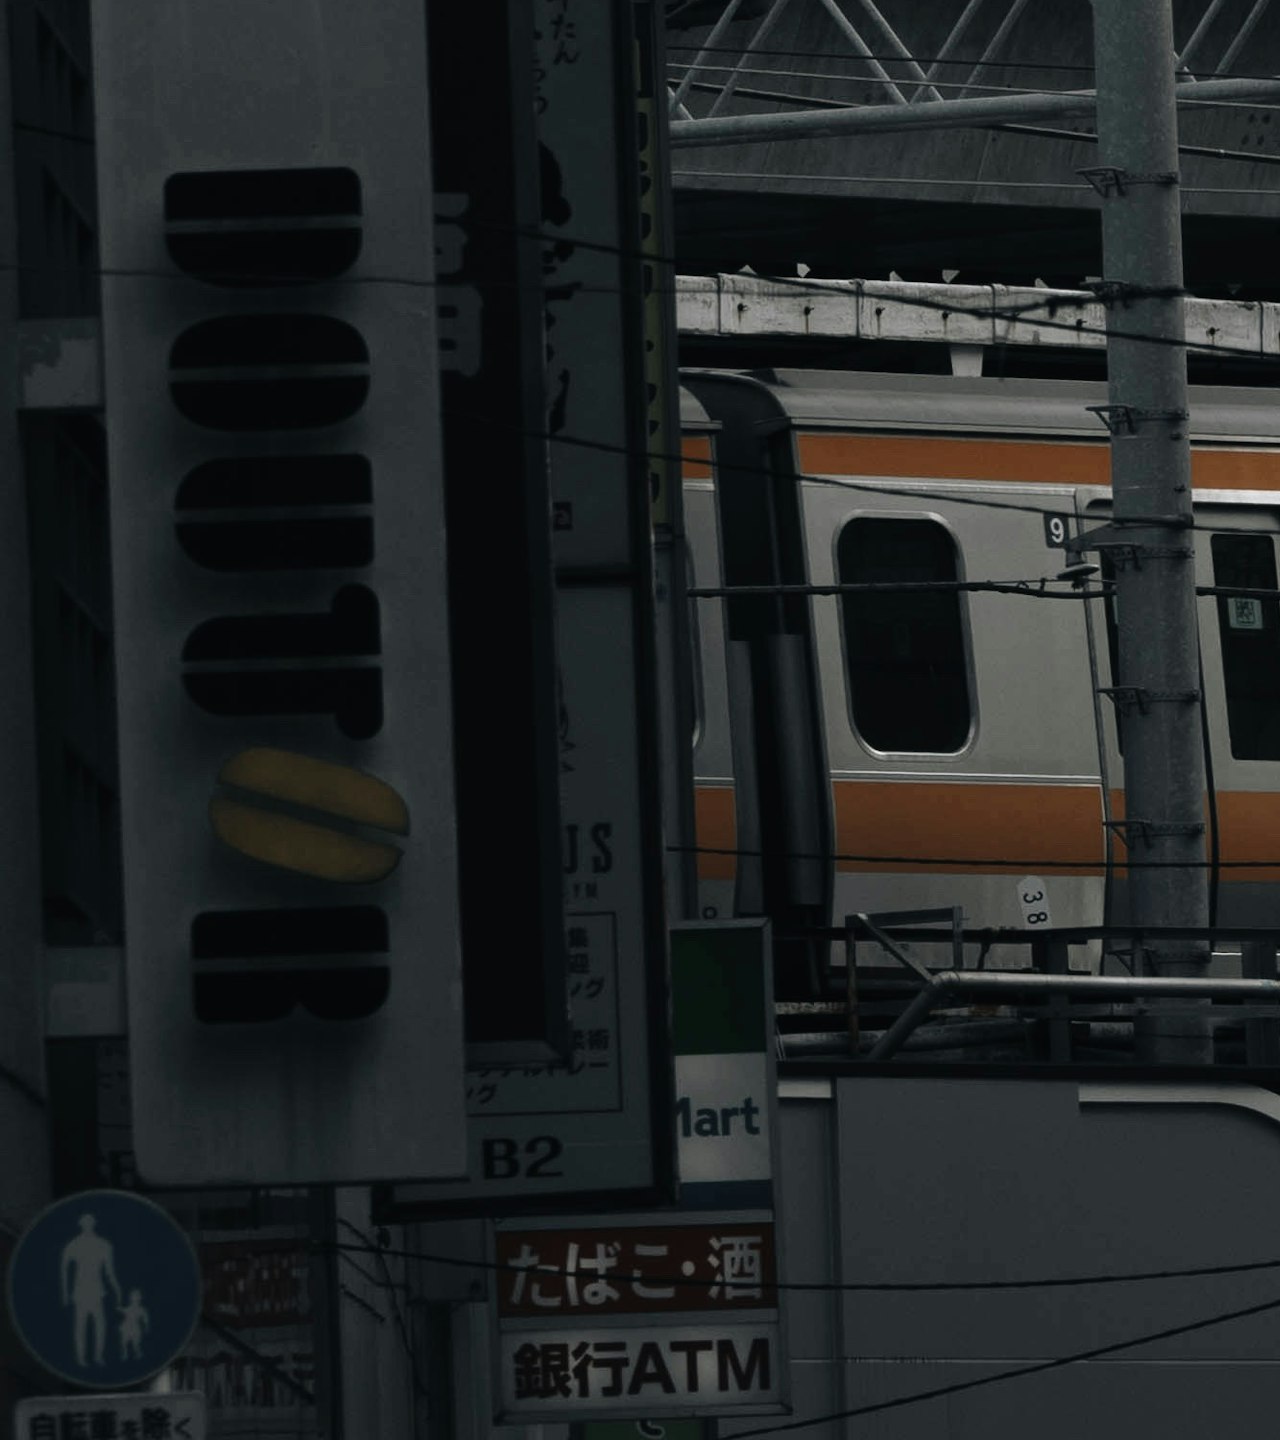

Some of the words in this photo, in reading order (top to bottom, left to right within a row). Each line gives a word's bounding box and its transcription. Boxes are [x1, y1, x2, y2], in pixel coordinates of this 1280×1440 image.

[1049, 516, 1065, 544] 9
[480, 1136, 564, 1180] B2
[508, 1235, 764, 1308] たばこ・酒
[513, 1337, 771, 1400] 銀行ATM
